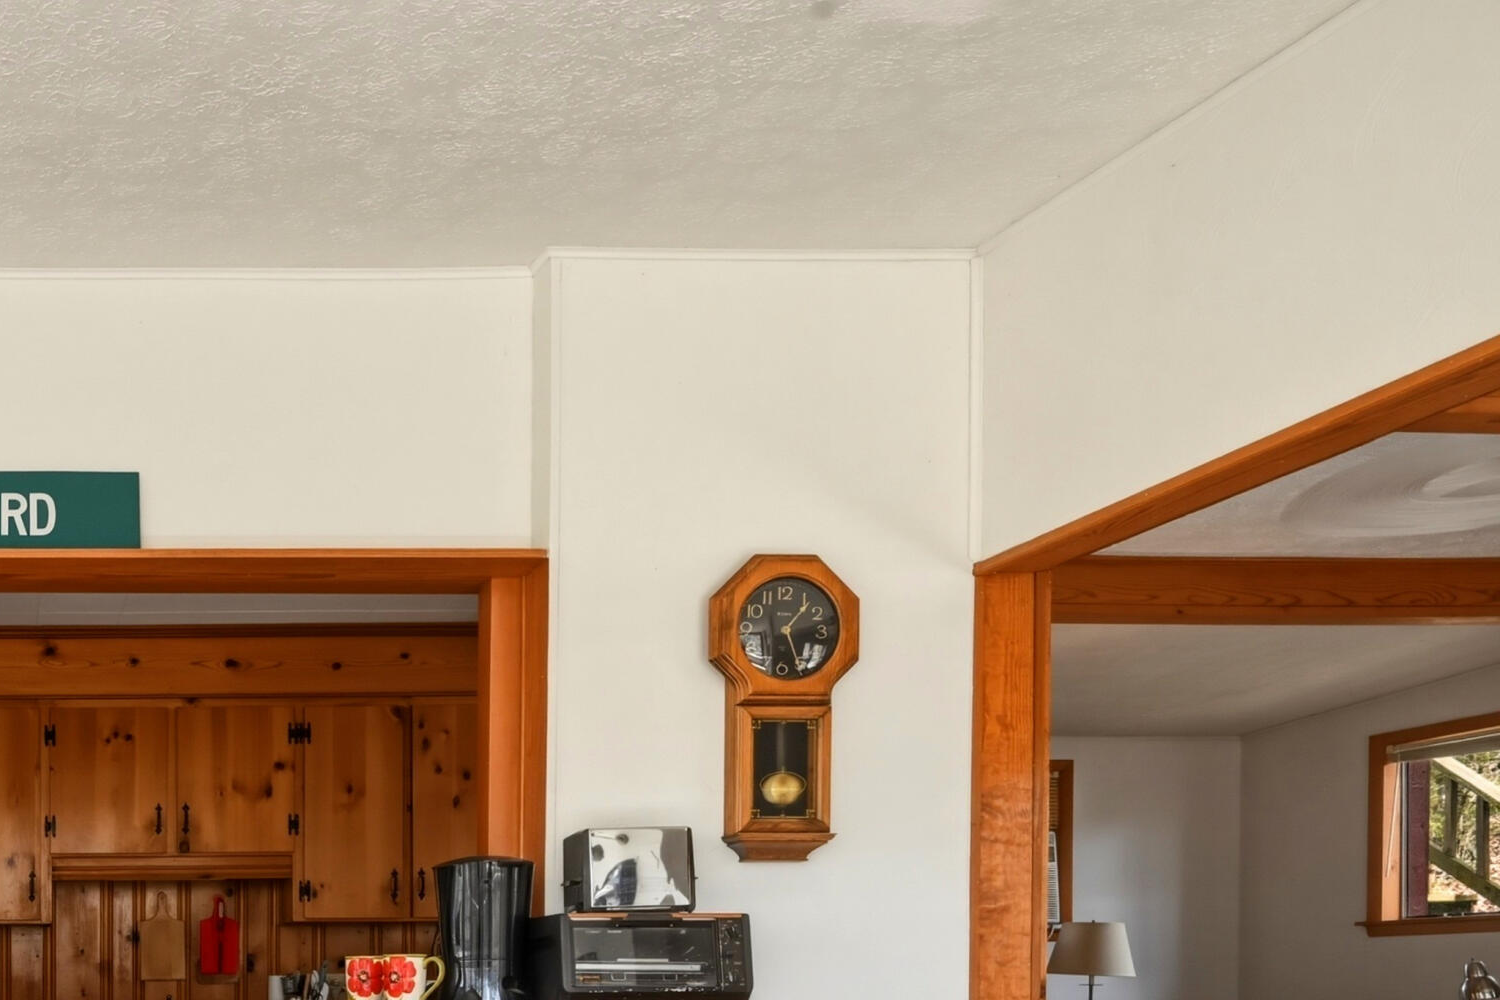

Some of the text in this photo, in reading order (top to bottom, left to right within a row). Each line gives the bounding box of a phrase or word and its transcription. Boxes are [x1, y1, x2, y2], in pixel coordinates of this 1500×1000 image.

[0, 492, 57, 536] RD
[762, 590, 773, 605] 11
[777, 586, 794, 601] 12
[747, 604, 763, 619] 10
[811, 606, 823, 621] 2
[815, 624, 828, 640] 3
[776, 660, 789, 676] 6
